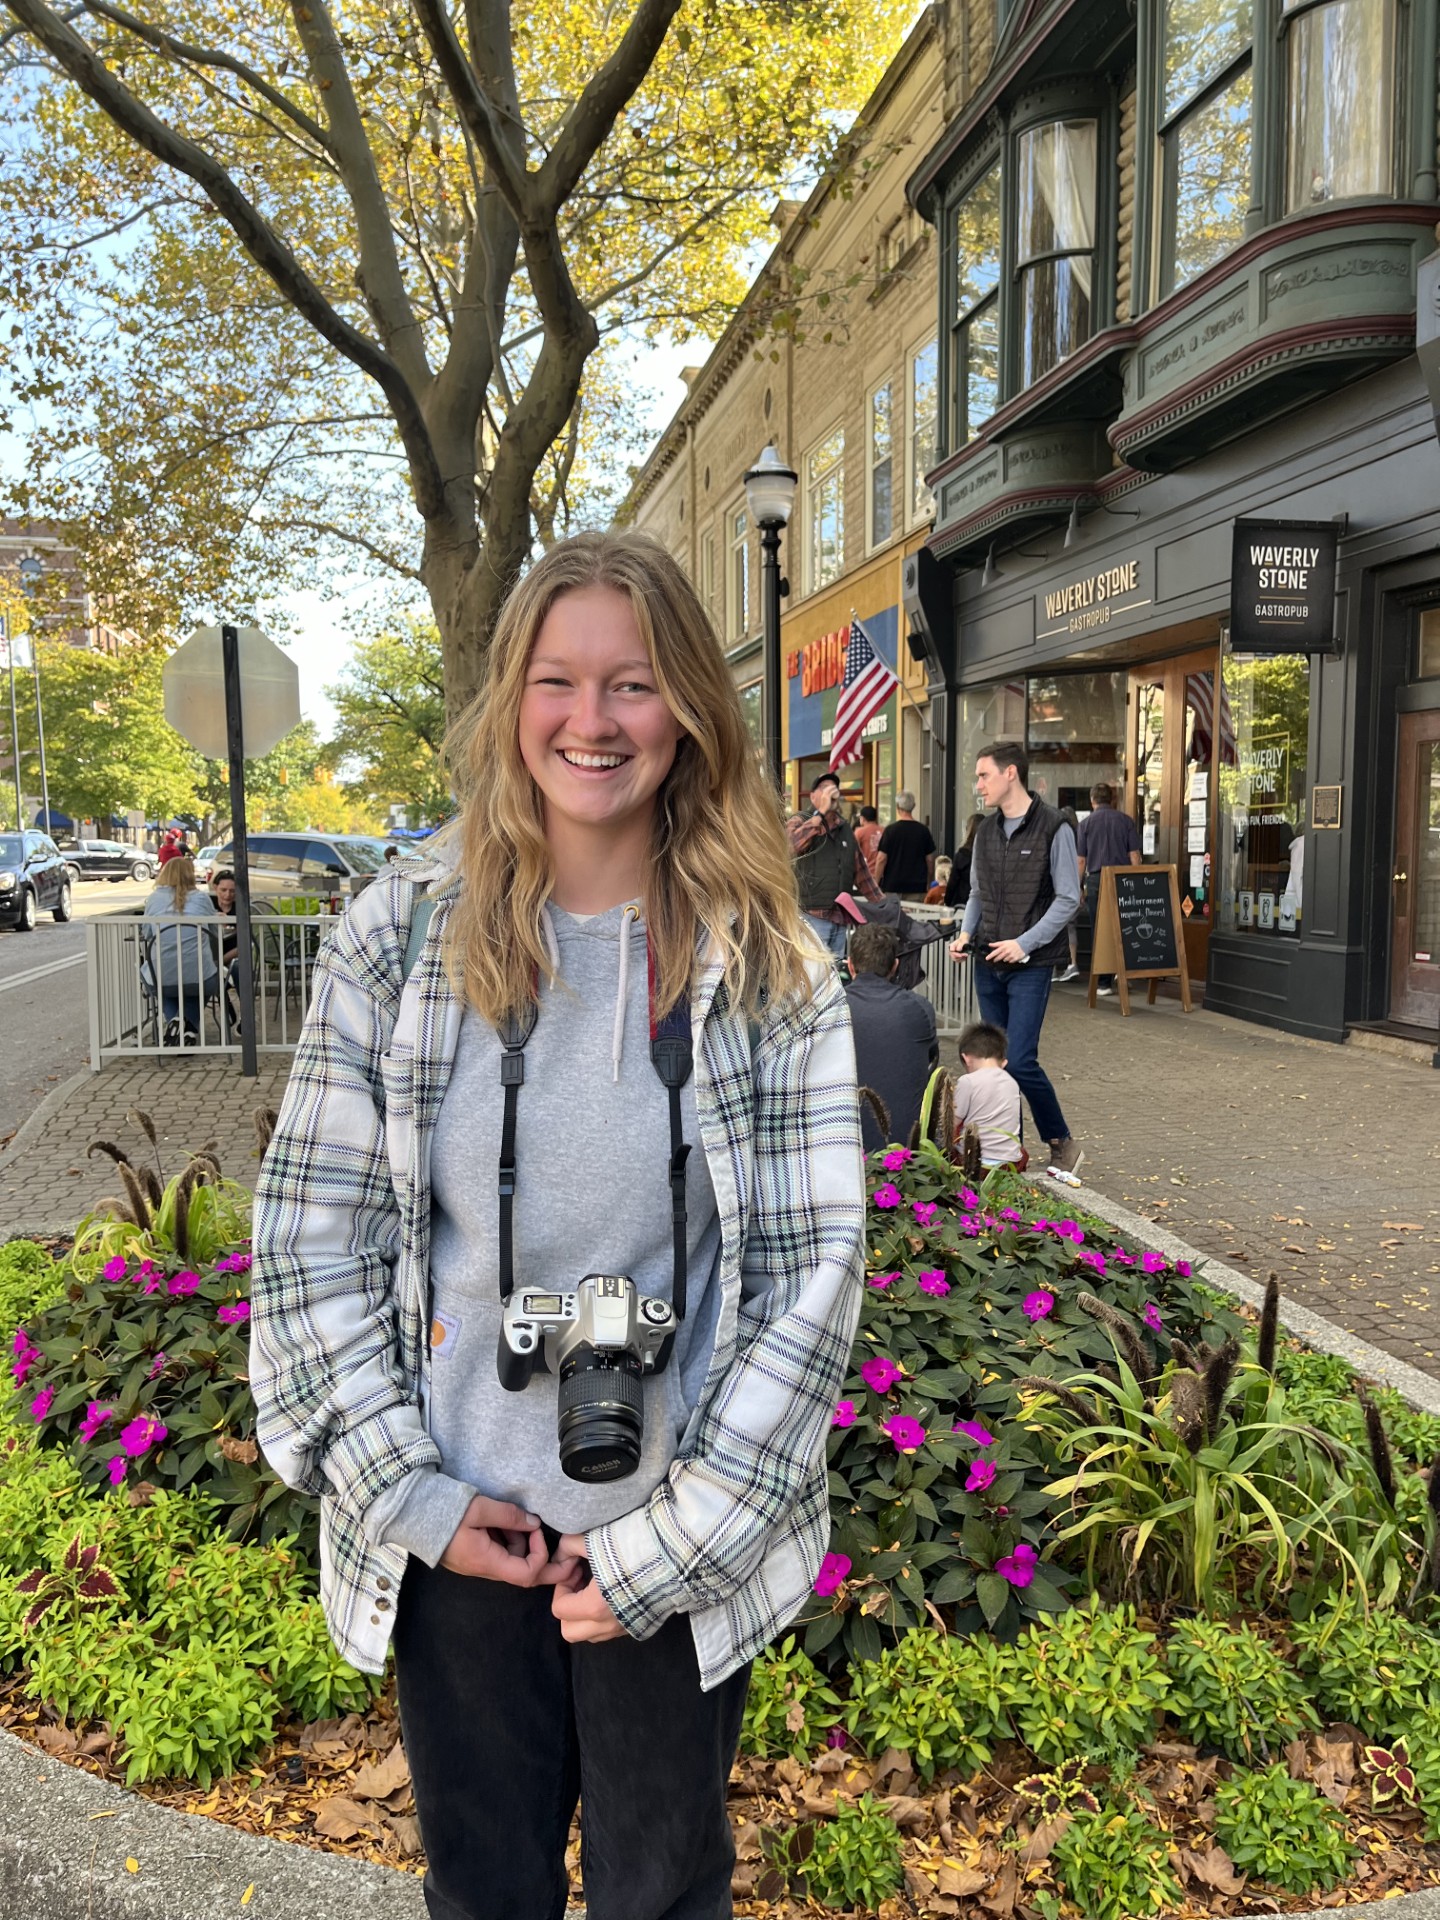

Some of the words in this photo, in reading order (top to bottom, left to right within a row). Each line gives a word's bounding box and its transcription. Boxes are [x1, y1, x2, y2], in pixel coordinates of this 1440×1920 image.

[1250, 545, 1320, 568] WAVERLY
[1045, 576, 1096, 620] WAVERLY
[1097, 560, 1139, 602] STONE
[1258, 568, 1308, 590] STONE
[1069, 606, 1110, 633] GASTROPUB
[1255, 604, 1309, 617] GASTROPUB
[802, 623, 852, 698] BRIDG
[1240, 746, 1285, 771] AVERLY
[1247, 769, 1277, 795] TONE
[1122, 877, 1134, 891] Try
